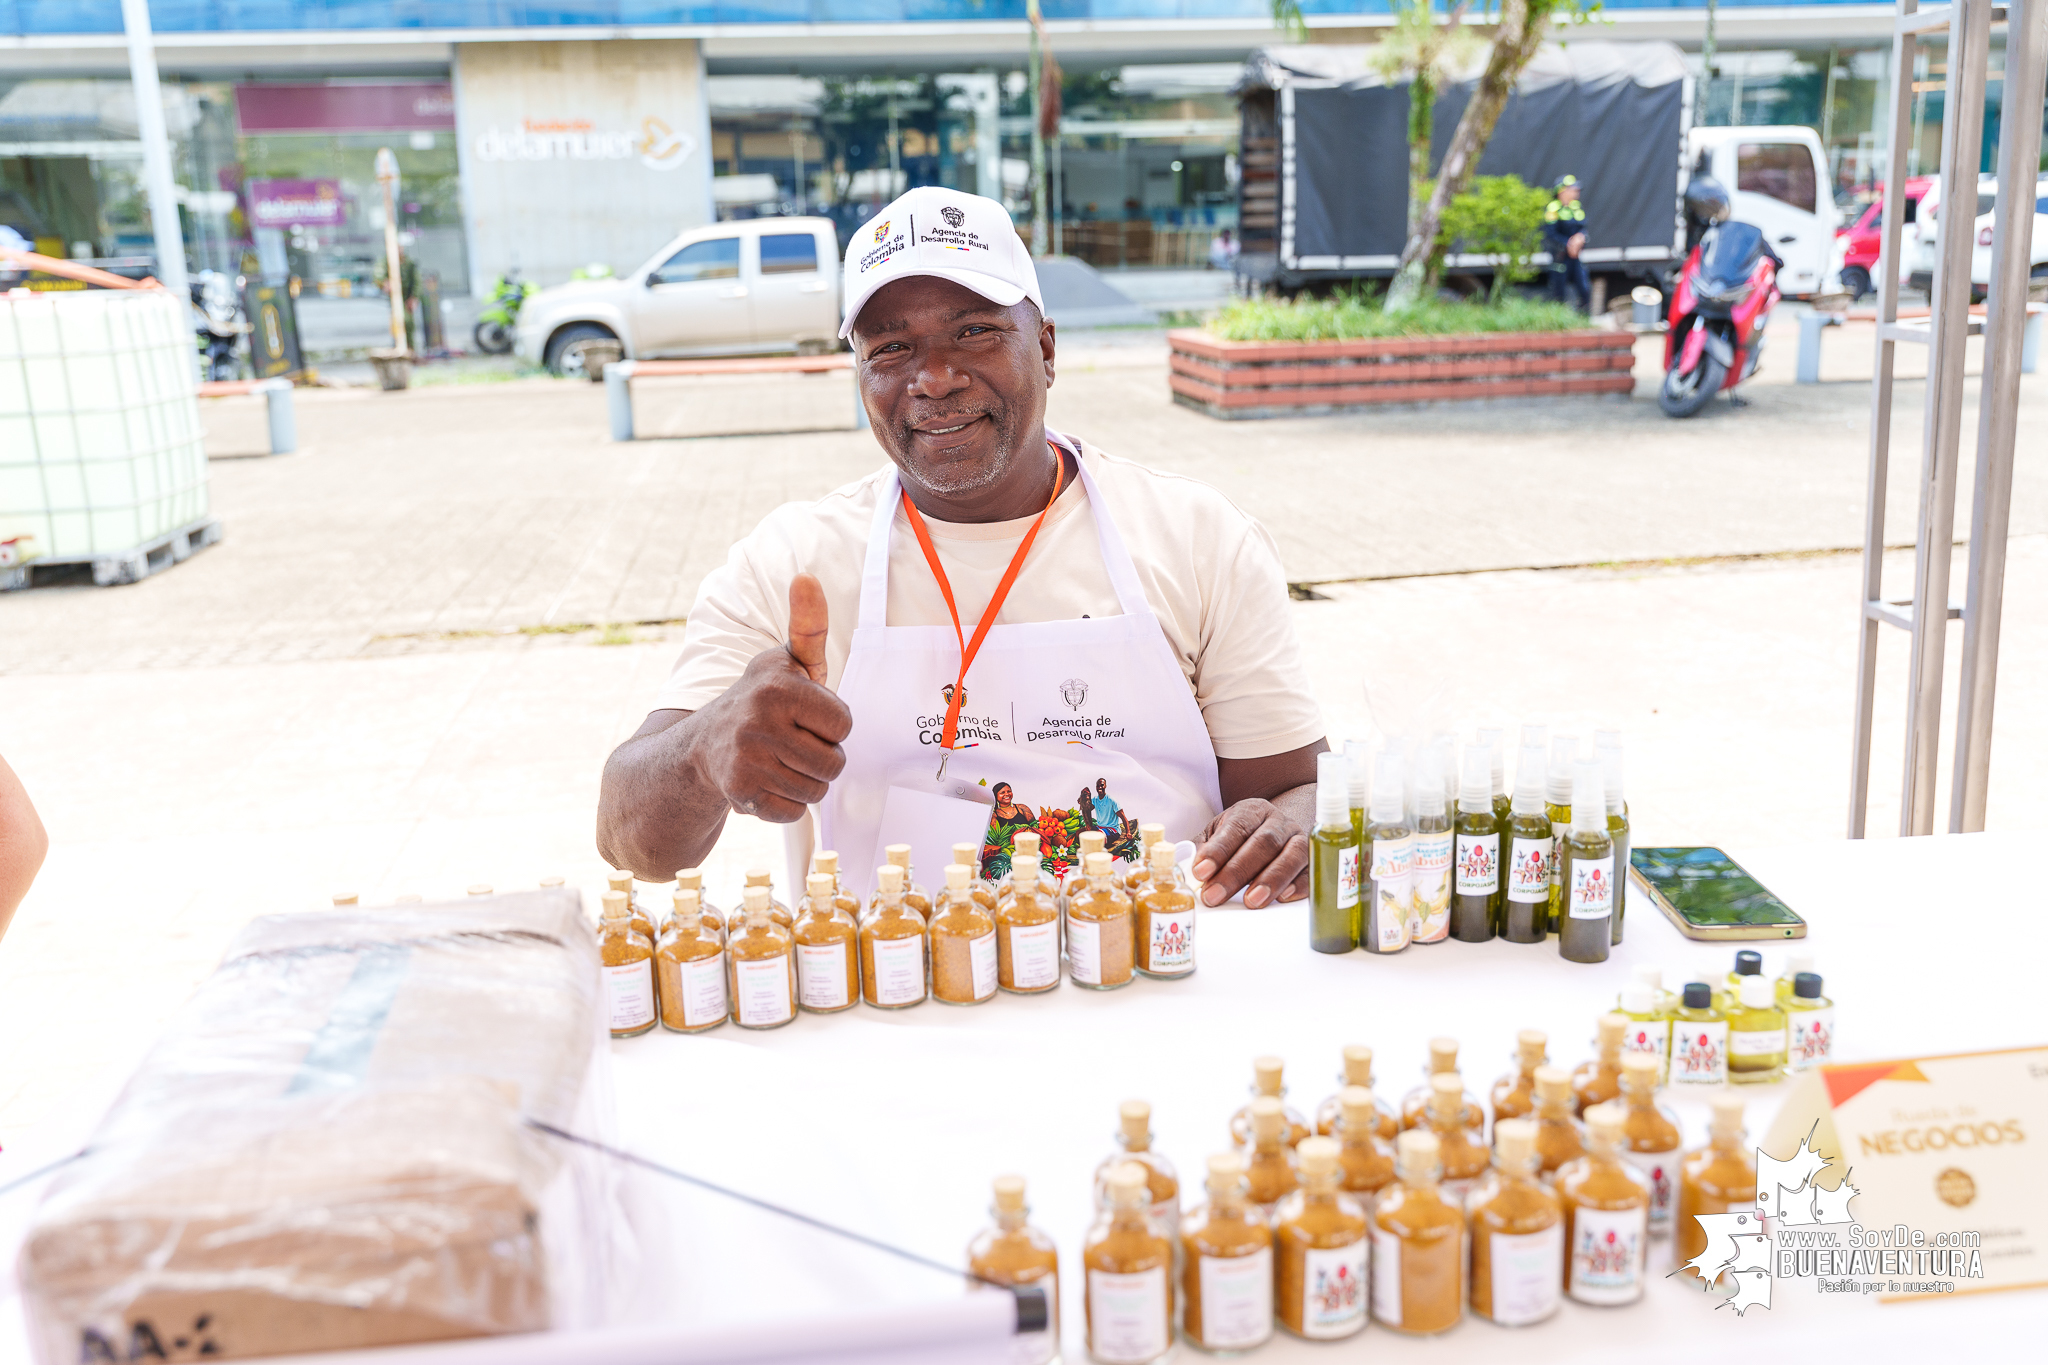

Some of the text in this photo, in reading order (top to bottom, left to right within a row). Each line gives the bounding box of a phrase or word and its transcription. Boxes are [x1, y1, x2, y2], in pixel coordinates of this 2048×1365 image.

[931, 227, 979, 240] Agencia de
[860, 234, 905, 265] Gobierno de
[921, 235, 989, 251] Desarrollo Rural
[860, 241, 905, 273] Colombia
[916, 714, 999, 729] Gobrno de
[1042, 715, 1112, 728] Agencia de
[1027, 728, 1125, 742] Desarrollo Rural
[1858, 1119, 2026, 1157] NEGOCIOS
